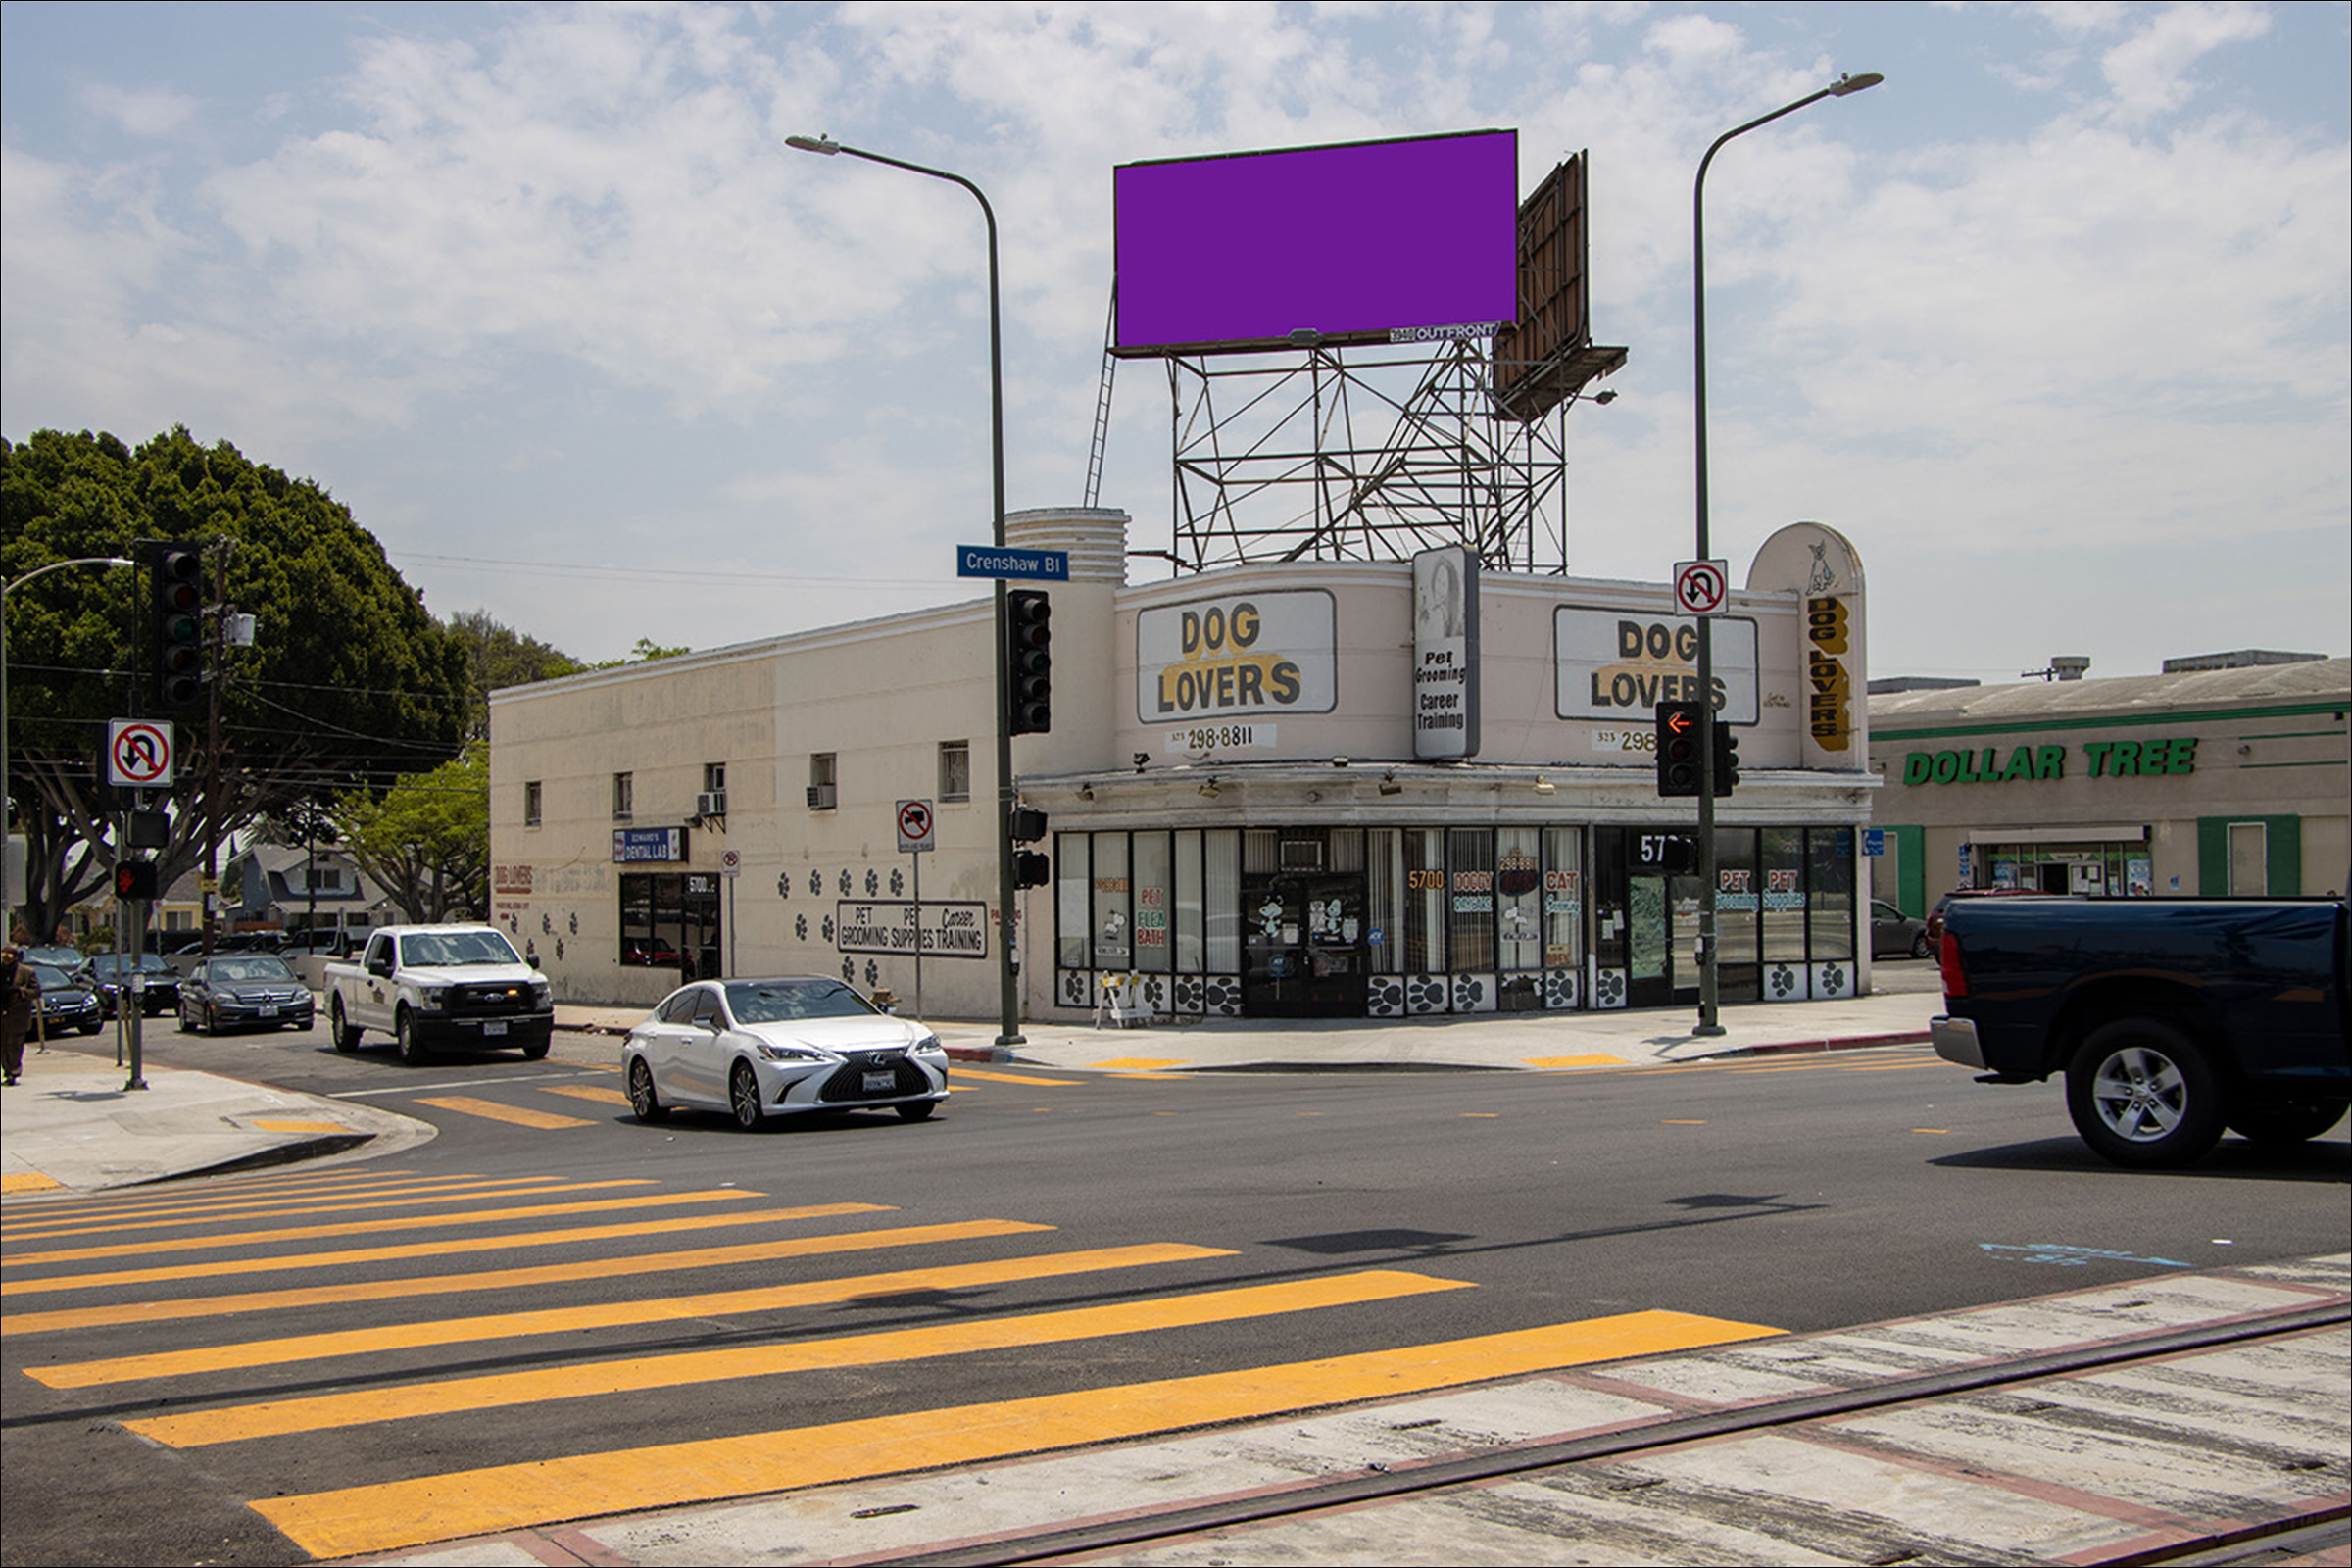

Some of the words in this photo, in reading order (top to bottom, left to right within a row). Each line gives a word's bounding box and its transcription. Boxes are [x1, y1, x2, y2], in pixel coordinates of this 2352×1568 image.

[1416, 323, 1496, 340] OUTFRONT
[966, 552, 1039, 572] Crenshaw
[1045, 556, 1060, 573] Bl
[1182, 602, 1260, 654] DOG
[1808, 596, 1838, 641] DOG
[1618, 620, 1698, 662] DOG
[1425, 650, 1453, 665] Pet
[1415, 664, 1466, 685] Grooming
[1158, 662, 1301, 713] LOVERS
[1809, 650, 1838, 737] LOVERS
[1420, 693, 1459, 710] Career
[1417, 711, 1464, 730] Training
[1903, 745, 2066, 786] DOLLAR
[2083, 737, 2199, 778] TREE
[626, 845, 652, 859] DENTAL
[653, 844, 667, 858] LAB
[1641, 835, 1678, 862] 57
[1408, 870, 1445, 889] 5700
[1453, 871, 1494, 891] DOGGY
[1545, 871, 1579, 891] CAT
[1721, 870, 1750, 890] PET
[1768, 870, 1797, 890] PET
[1141, 888, 1163, 906] PET
[1715, 889, 1759, 912] Grooming
[1763, 888, 1805, 912] Supplies
[856, 906, 873, 924] PET
[904, 907, 922, 926] PE
[942, 908, 976, 929] Career
[1138, 911, 1166, 928] FLEA
[842, 926, 888, 947] GROOMING
[935, 929, 982, 951] TRAINING
[1137, 928, 1166, 946] BATH
